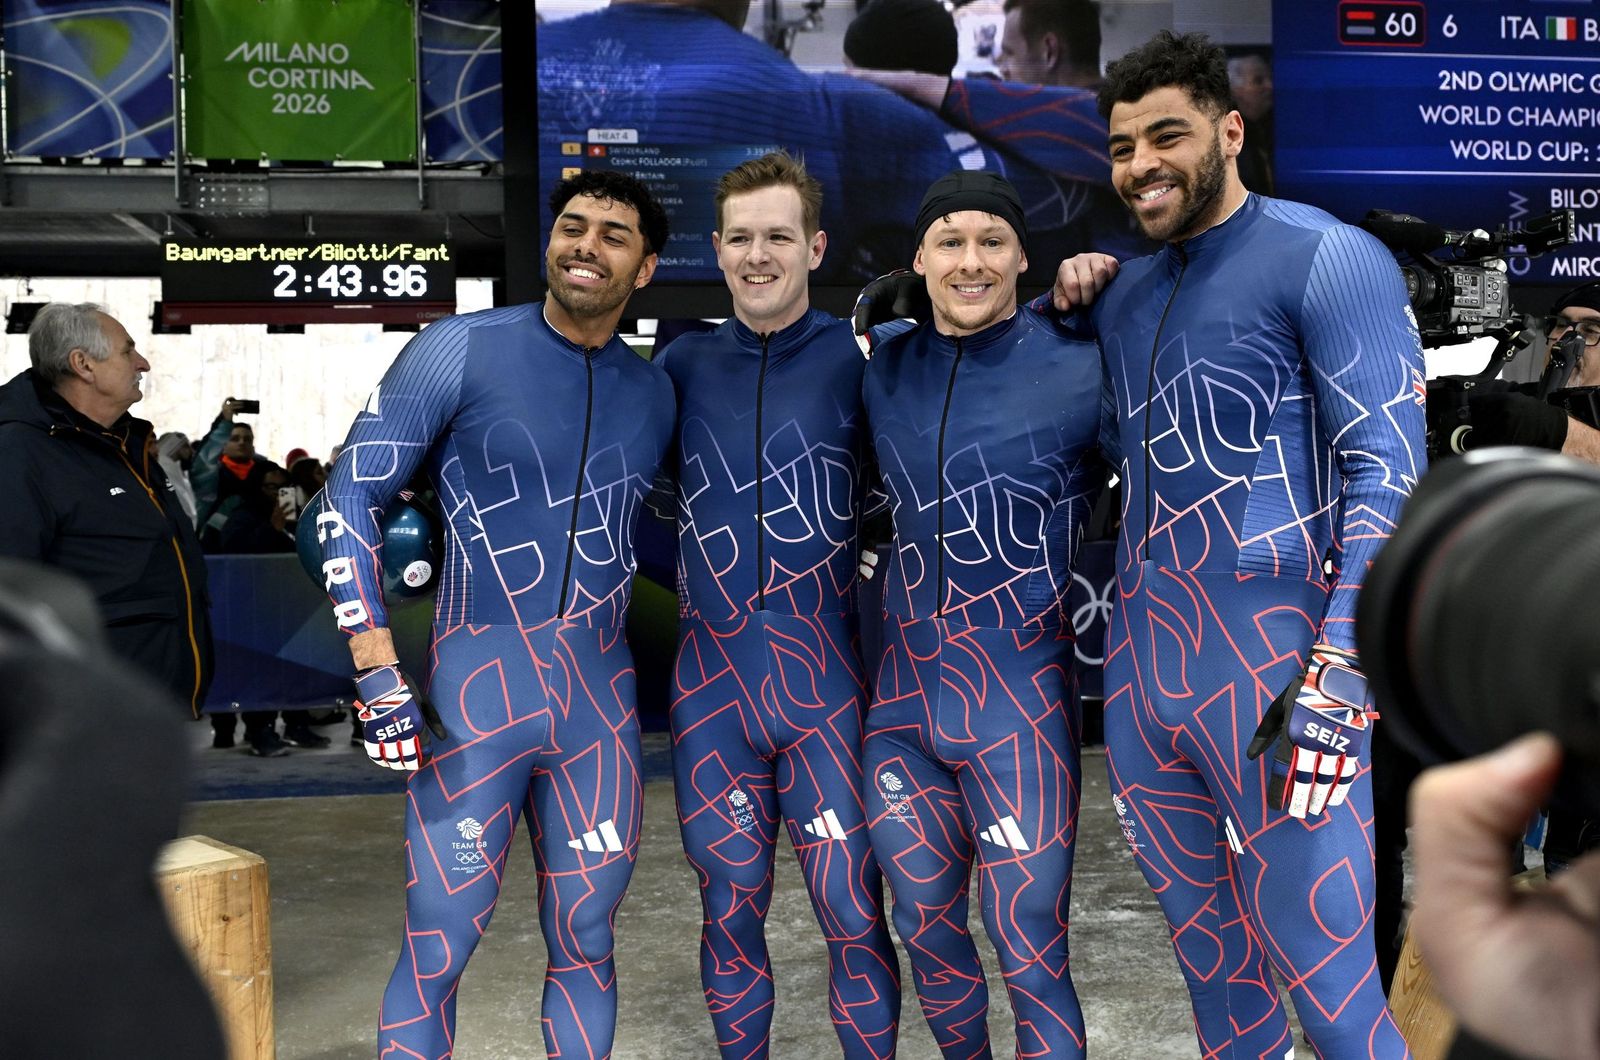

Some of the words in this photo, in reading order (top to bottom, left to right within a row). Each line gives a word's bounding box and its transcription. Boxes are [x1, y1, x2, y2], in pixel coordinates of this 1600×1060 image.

[1384, 12, 1417, 37] 60
[1442, 14, 1458, 38] 6
[1500, 15, 1540, 40] ITA
[1584, 18, 1600, 42] B
[224, 41, 350, 64] MILANO
[247, 66, 376, 90] CORTINA
[1438, 69, 1483, 91] 2ND
[1488, 70, 1585, 93] OLYMPIC
[271, 92, 331, 114] 2026
[1418, 104, 1502, 126] WORLD
[1507, 106, 1600, 127] CHAMPI
[597, 131, 621, 140] HEAT
[622, 131, 629, 140] 4
[1450, 139, 1532, 161] WORLD
[1538, 141, 1590, 162] CUP:
[1551, 188, 1600, 209] BILO
[165, 243, 450, 263] Baumgartner/Bilotti/Fant
[273, 264, 427, 297] 2:43.96
[451, 841, 475, 850] TEAM
[476, 840, 488, 849] GB
